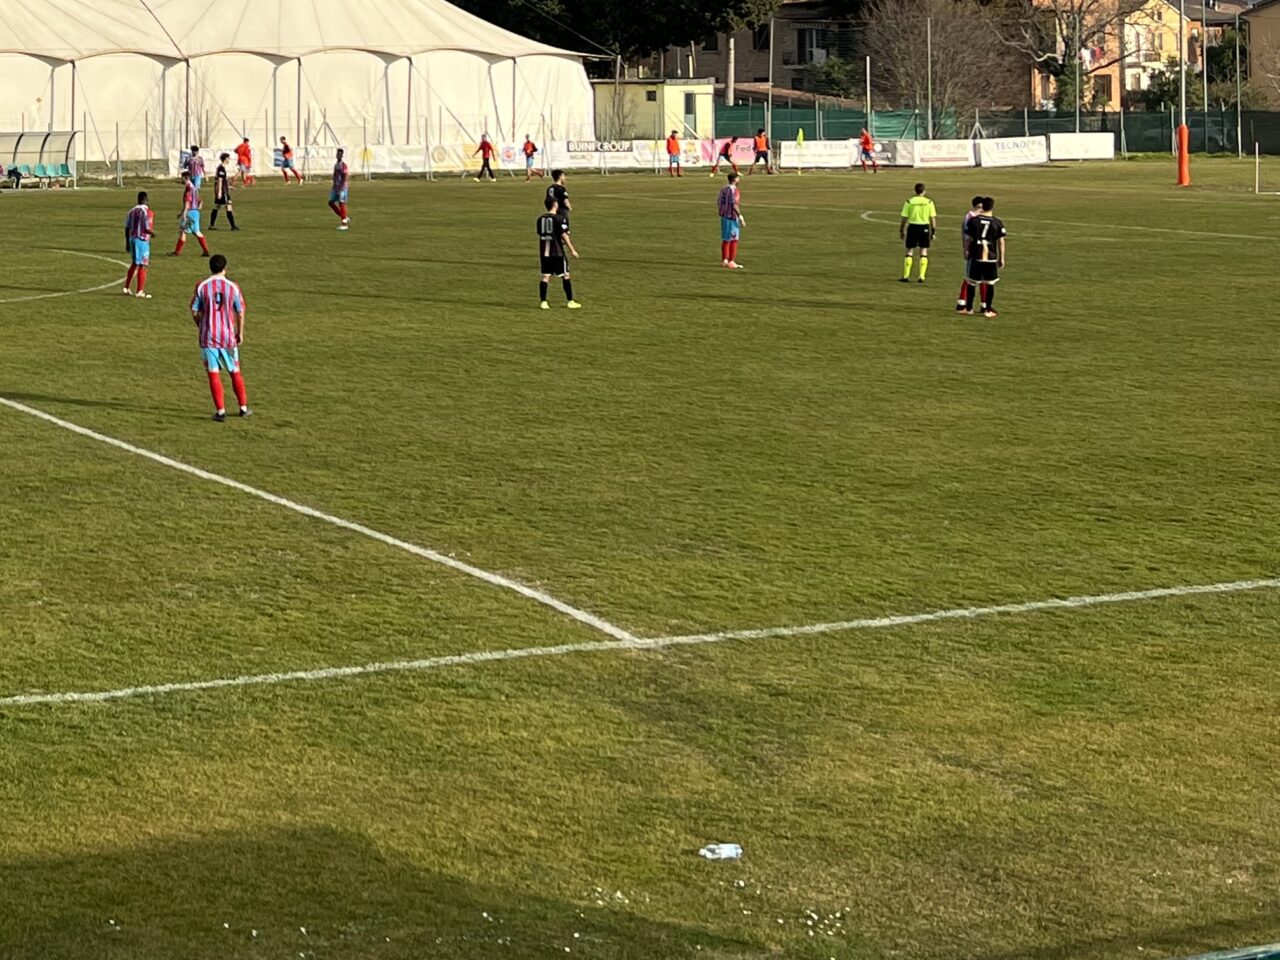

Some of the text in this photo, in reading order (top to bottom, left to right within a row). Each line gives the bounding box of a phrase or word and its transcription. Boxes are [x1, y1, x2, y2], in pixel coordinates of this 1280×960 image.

[568, 141, 595, 152] BUINI
[541, 217, 553, 234] 10
[980, 220, 990, 238] 7
[214, 291, 224, 312] 9
